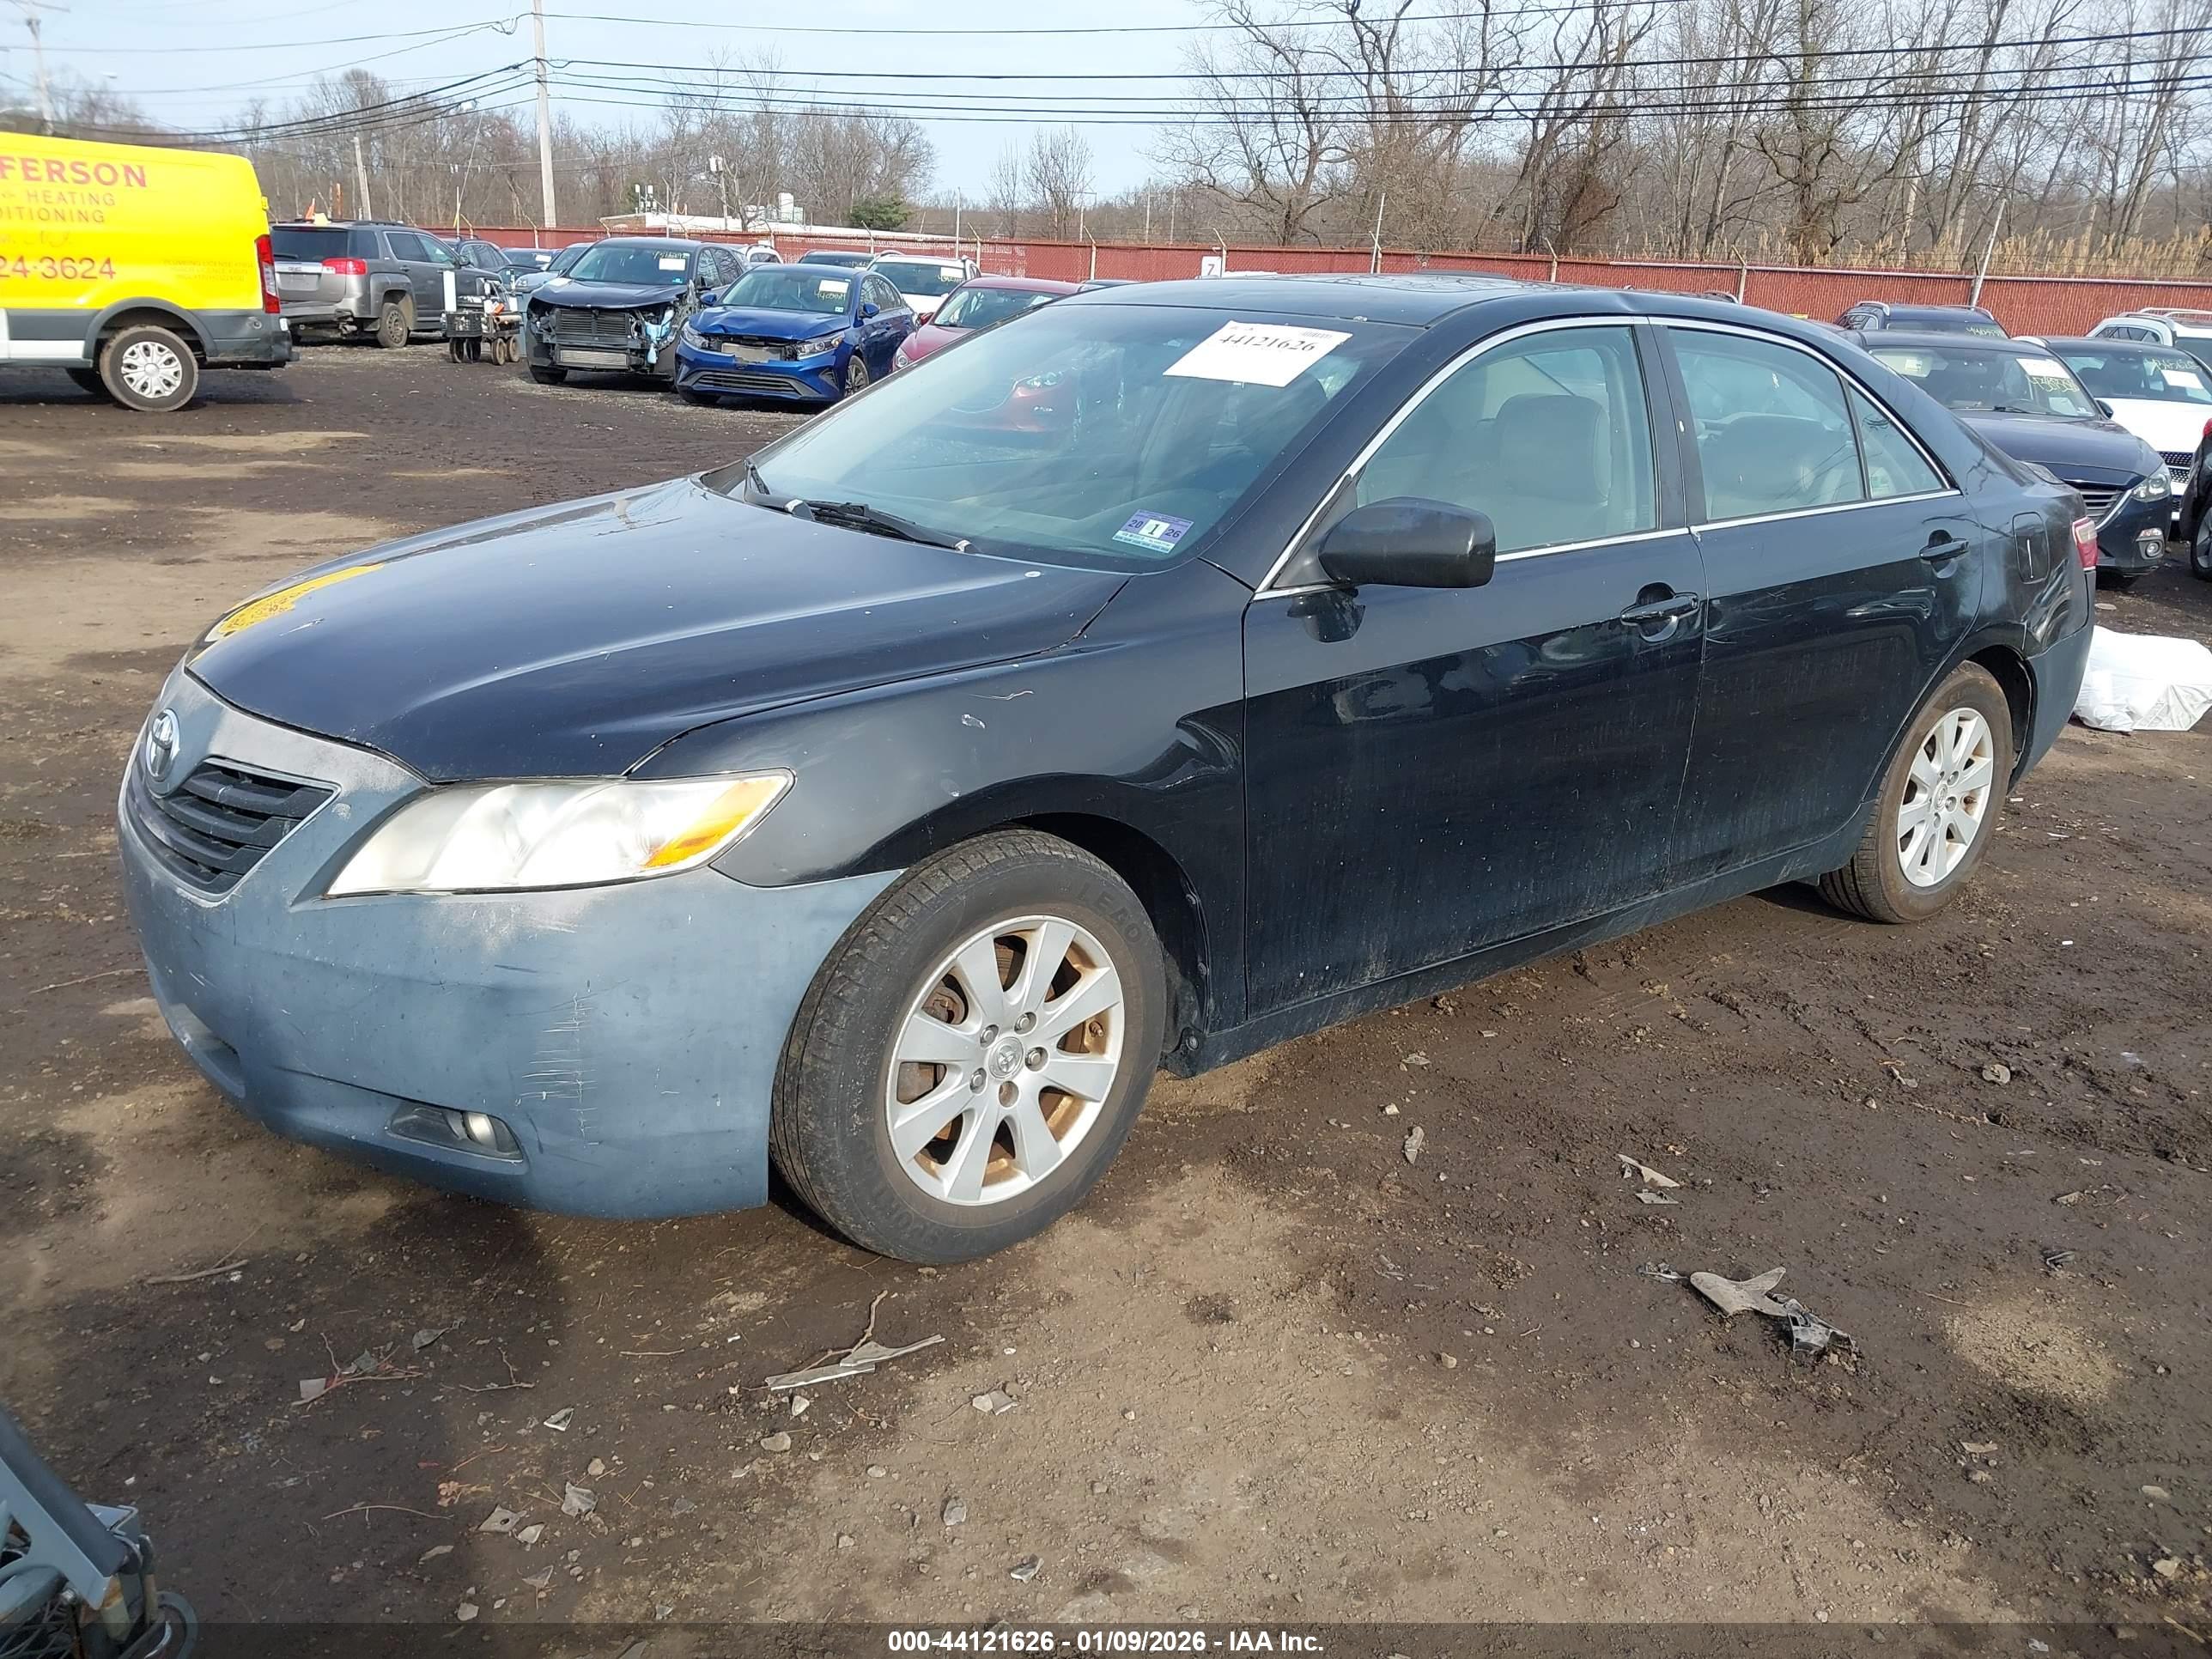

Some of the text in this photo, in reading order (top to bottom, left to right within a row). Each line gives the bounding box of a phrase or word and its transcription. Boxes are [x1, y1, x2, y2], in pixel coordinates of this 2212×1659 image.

[27, 189, 115, 206] HEATING
[0, 205, 105, 223] ITIONING
[1208, 264, 1215, 276] 7
[1219, 334, 1318, 351] 44121626
[1127, 520, 1182, 538] 20 1 26
